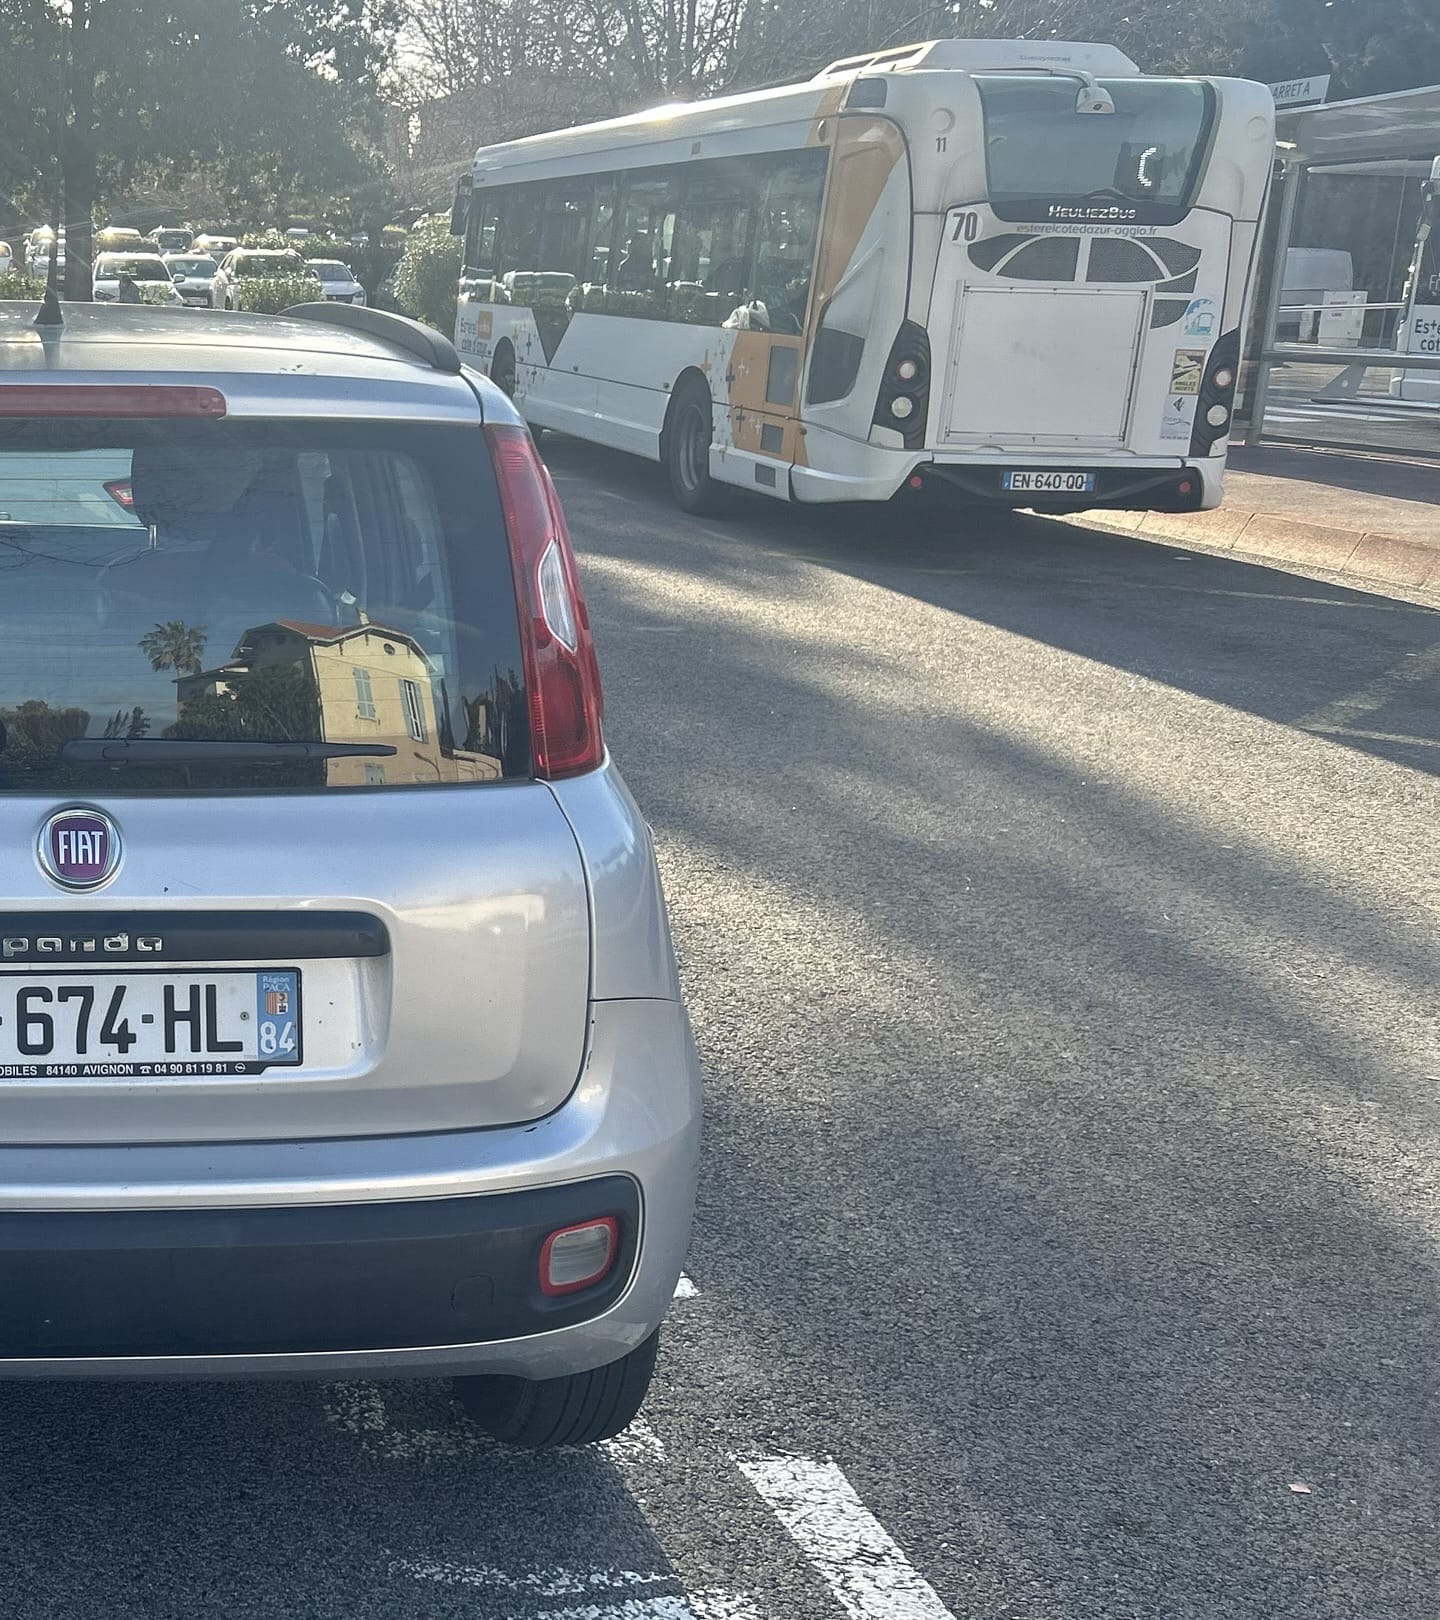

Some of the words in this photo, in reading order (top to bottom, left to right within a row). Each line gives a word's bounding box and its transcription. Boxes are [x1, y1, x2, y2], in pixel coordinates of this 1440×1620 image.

[935, 137, 947, 152] 11
[951, 212, 978, 242] 70
[58, 830, 104, 865] FIAT
[2, 932, 162, 957] panda
[262, 982, 291, 992] PACA
[263, 975, 290, 984] Région
[259, 1021, 296, 1054] 84
[46, 1065, 77, 1076] 84140
[82, 1064, 134, 1075] AVIGNON
[154, 1064, 167, 1074] 04
[170, 1064, 183, 1073] 90
[185, 1063, 197, 1073] 81
[200, 1063, 213, 1073] 19
[215, 1063, 227, 1073] 81
